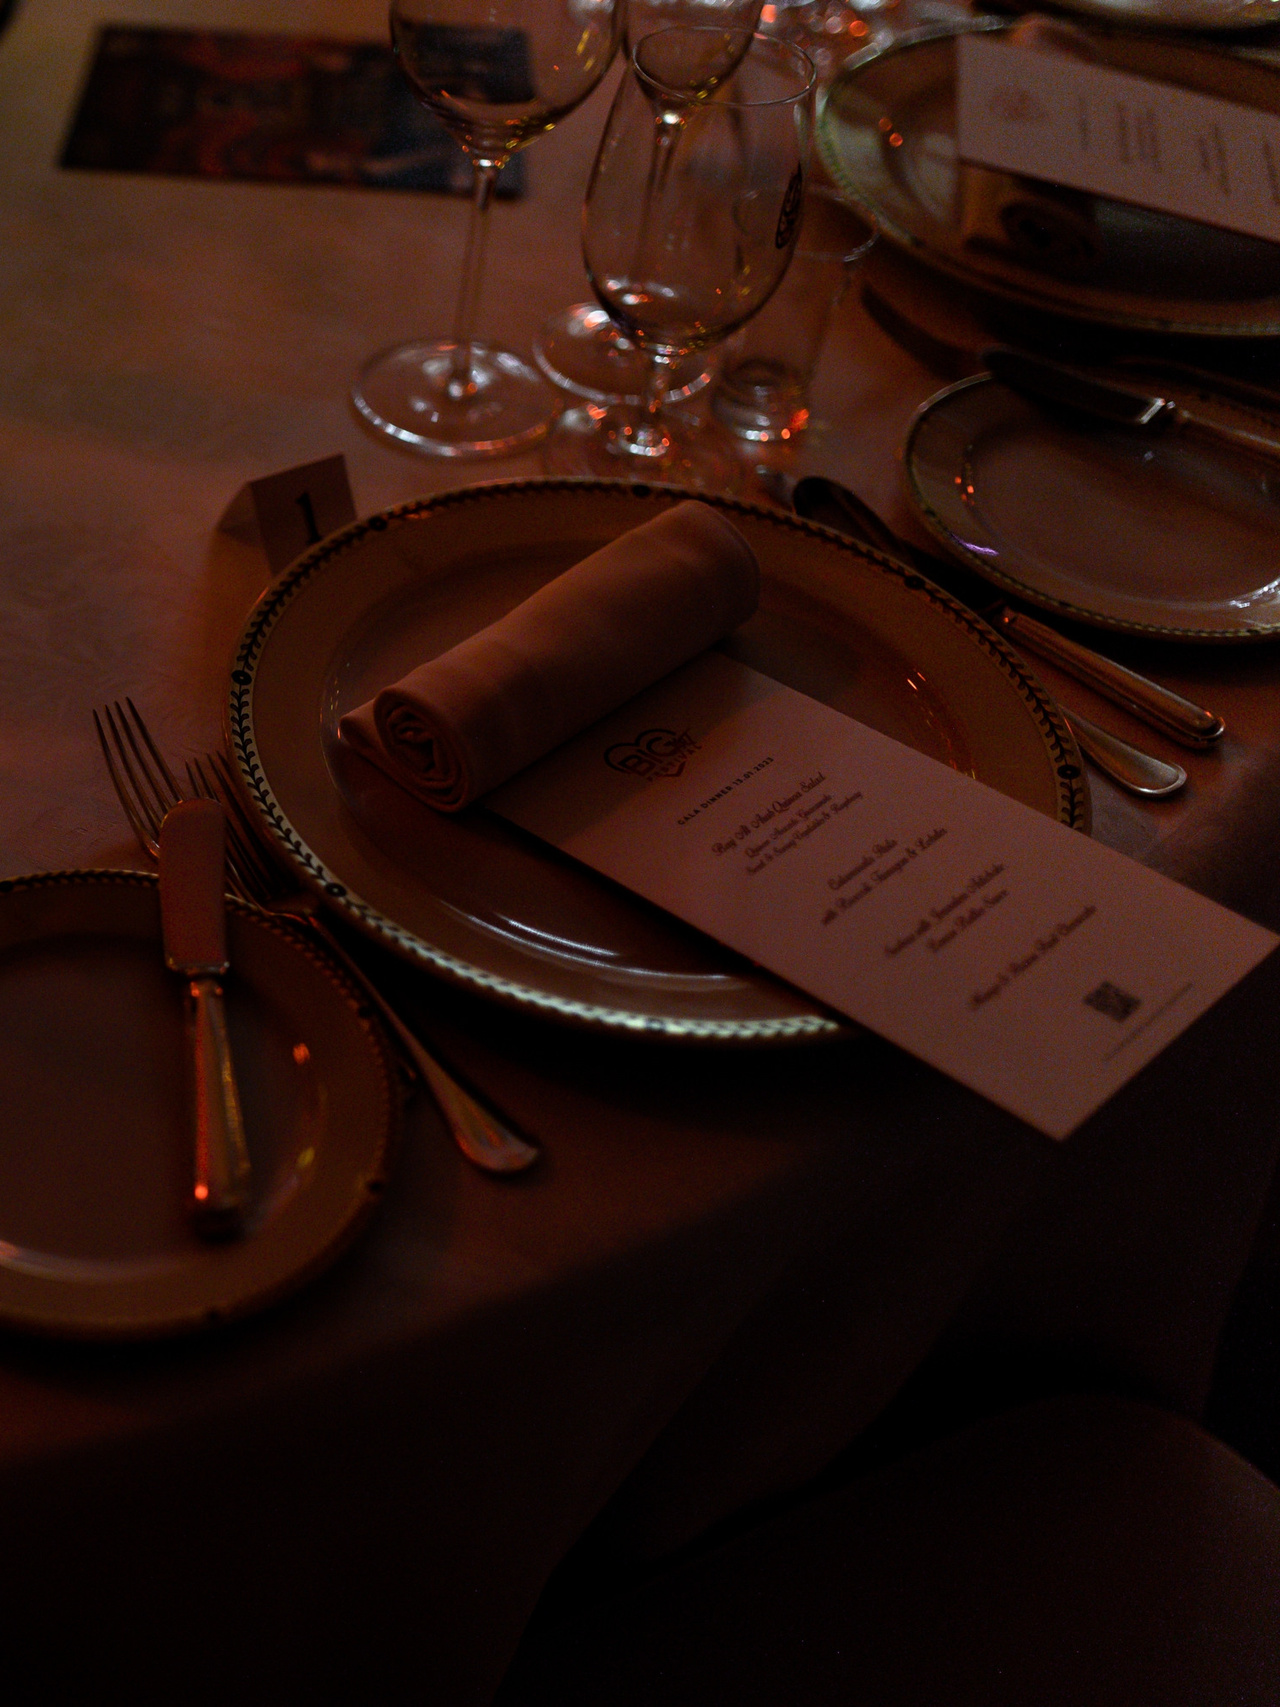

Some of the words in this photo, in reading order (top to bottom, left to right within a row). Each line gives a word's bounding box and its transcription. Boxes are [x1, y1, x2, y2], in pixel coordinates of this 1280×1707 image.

[295, 492, 320, 545] 1
[617, 736, 682, 776] BIG
[676, 808, 700, 825] GALA
[699, 785, 732, 808] DINNER
[732, 756, 774, 785] 13.01.2023
[799, 770, 827, 793] Salad
